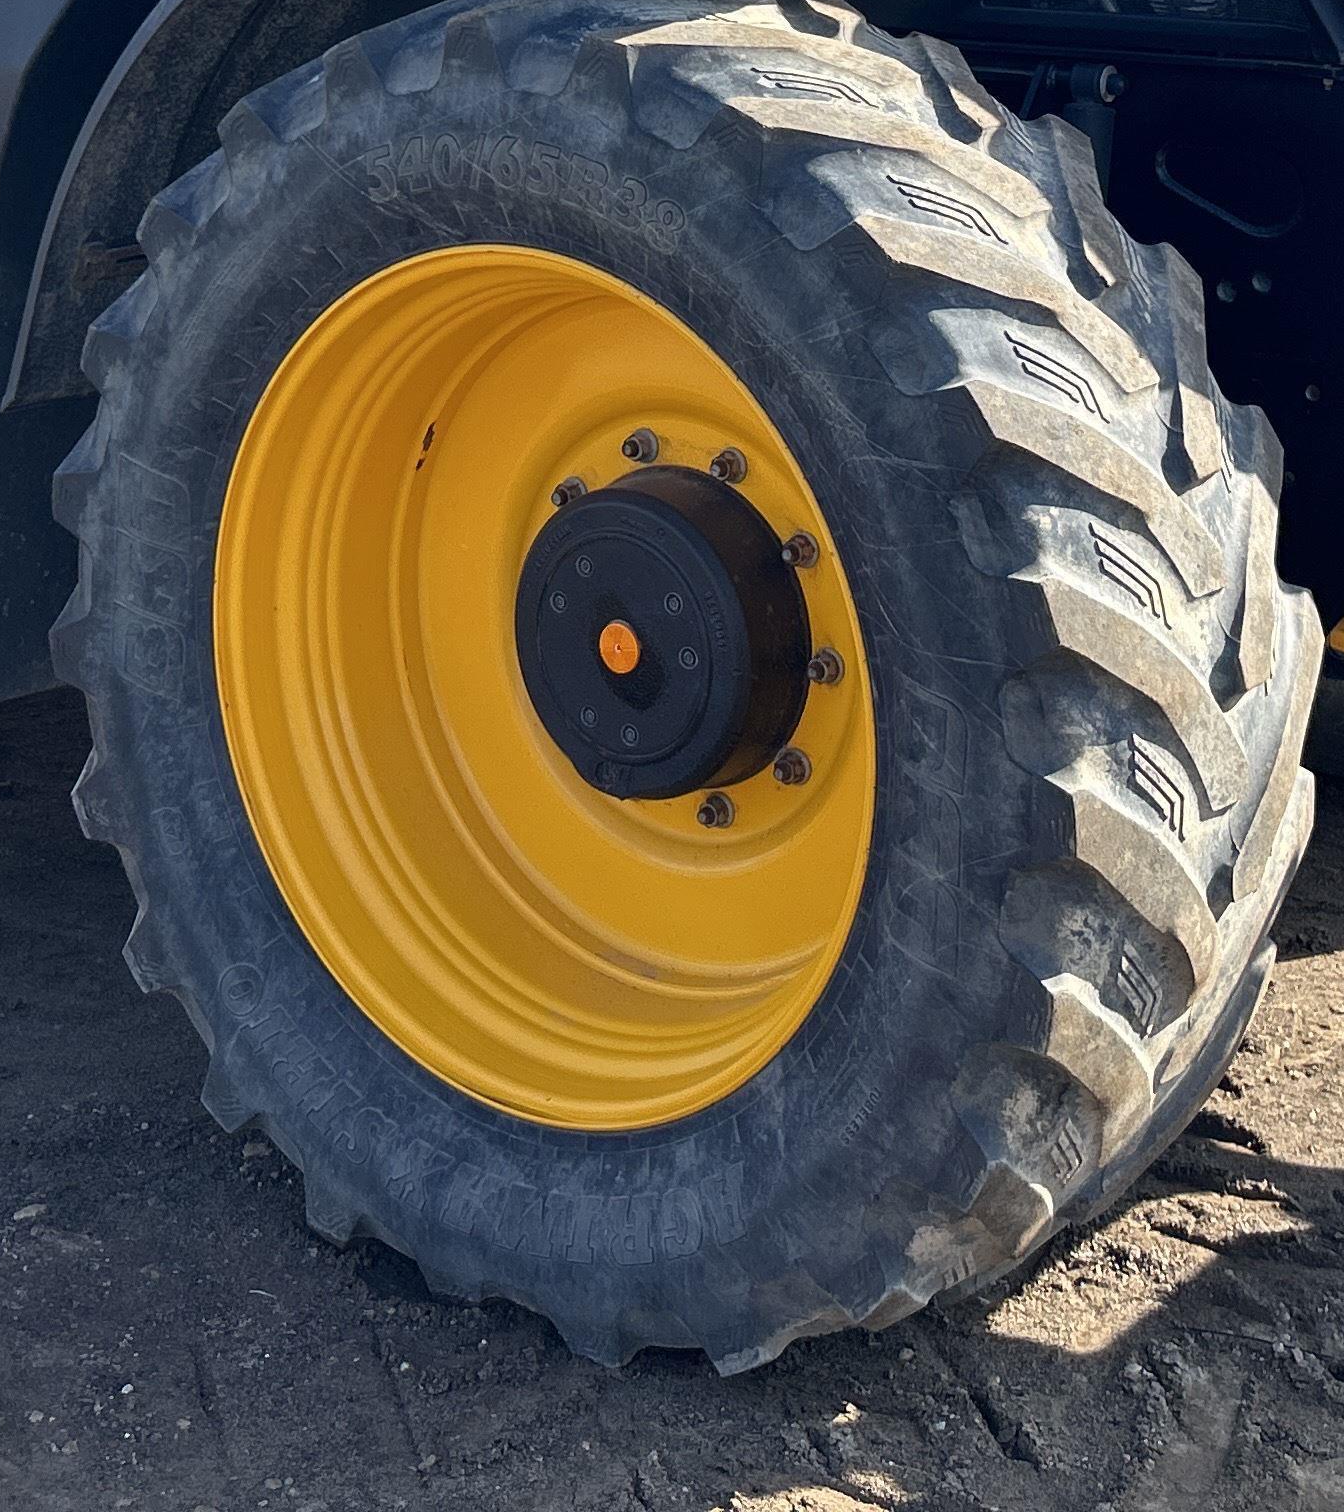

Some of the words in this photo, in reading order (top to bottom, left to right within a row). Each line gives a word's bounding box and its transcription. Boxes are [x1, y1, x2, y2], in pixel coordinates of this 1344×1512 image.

[363, 133, 687, 255] 540/65R38
[218, 962, 399, 1165] SIRIO
[839, 1086, 881, 1145] TUBELESS
[385, 1136, 748, 1266] AGRIMAX
